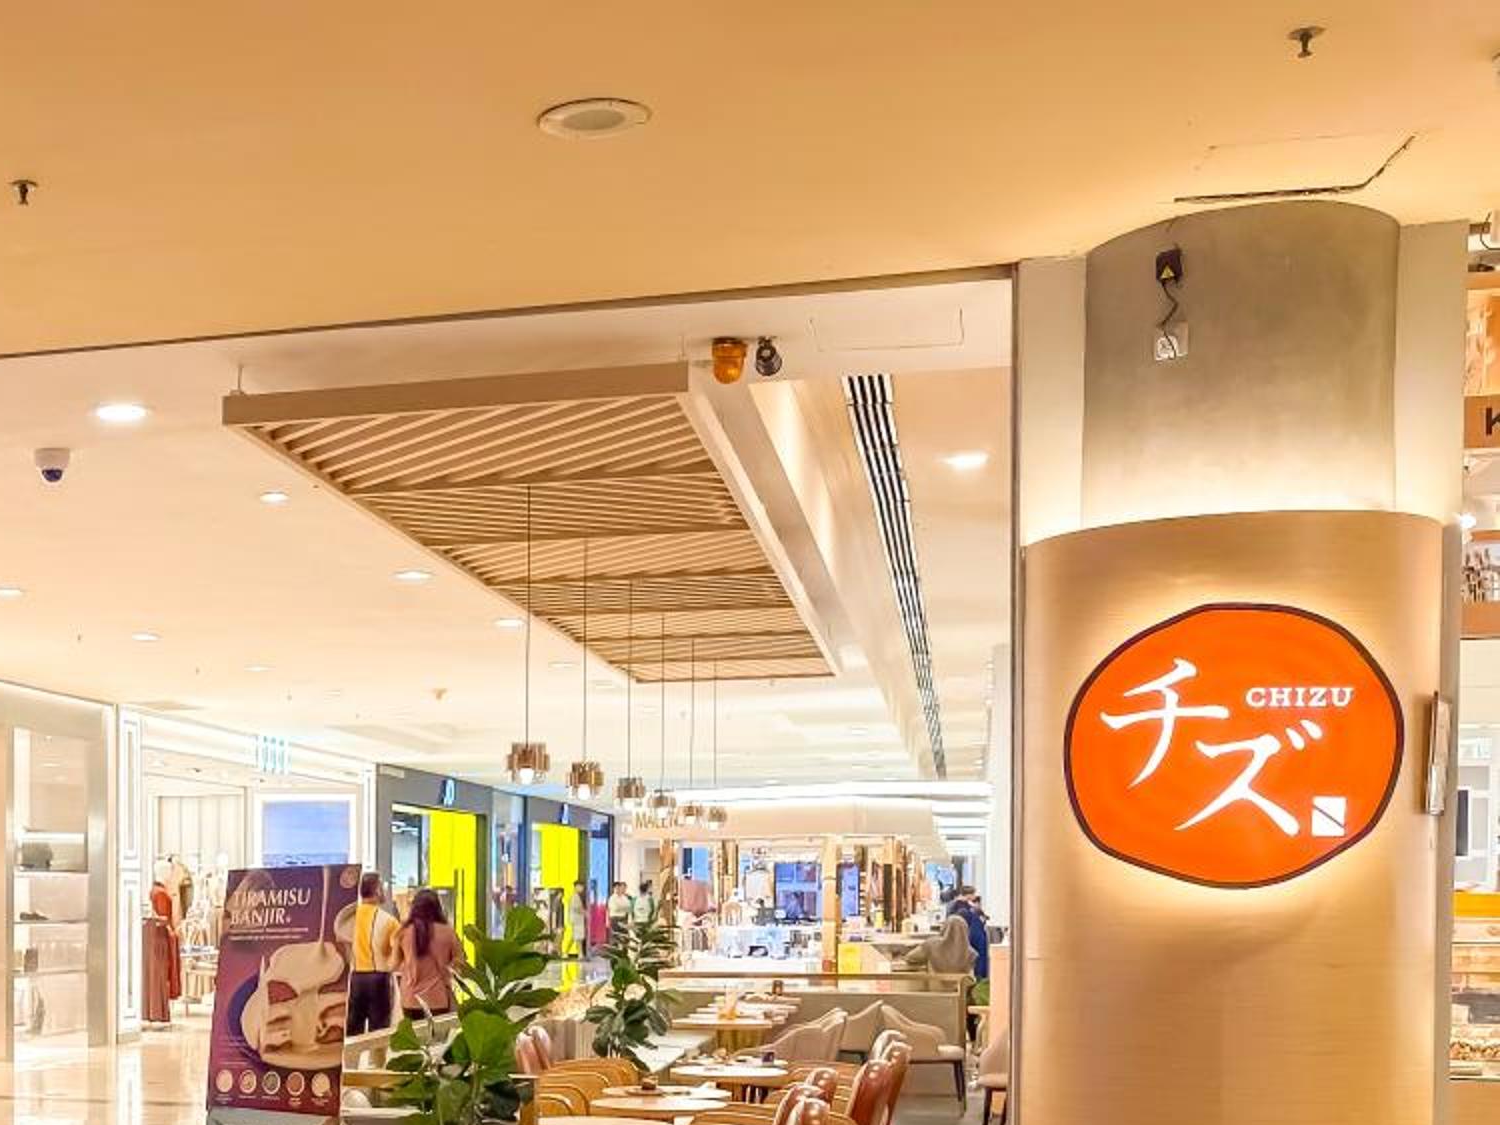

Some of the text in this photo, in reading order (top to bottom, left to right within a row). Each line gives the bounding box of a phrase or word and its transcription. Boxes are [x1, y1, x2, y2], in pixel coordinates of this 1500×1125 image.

[1245, 686, 1354, 708] CHIZU
[1100, 657, 1324, 837] チズ
[233, 887, 311, 908] TIRAMISU
